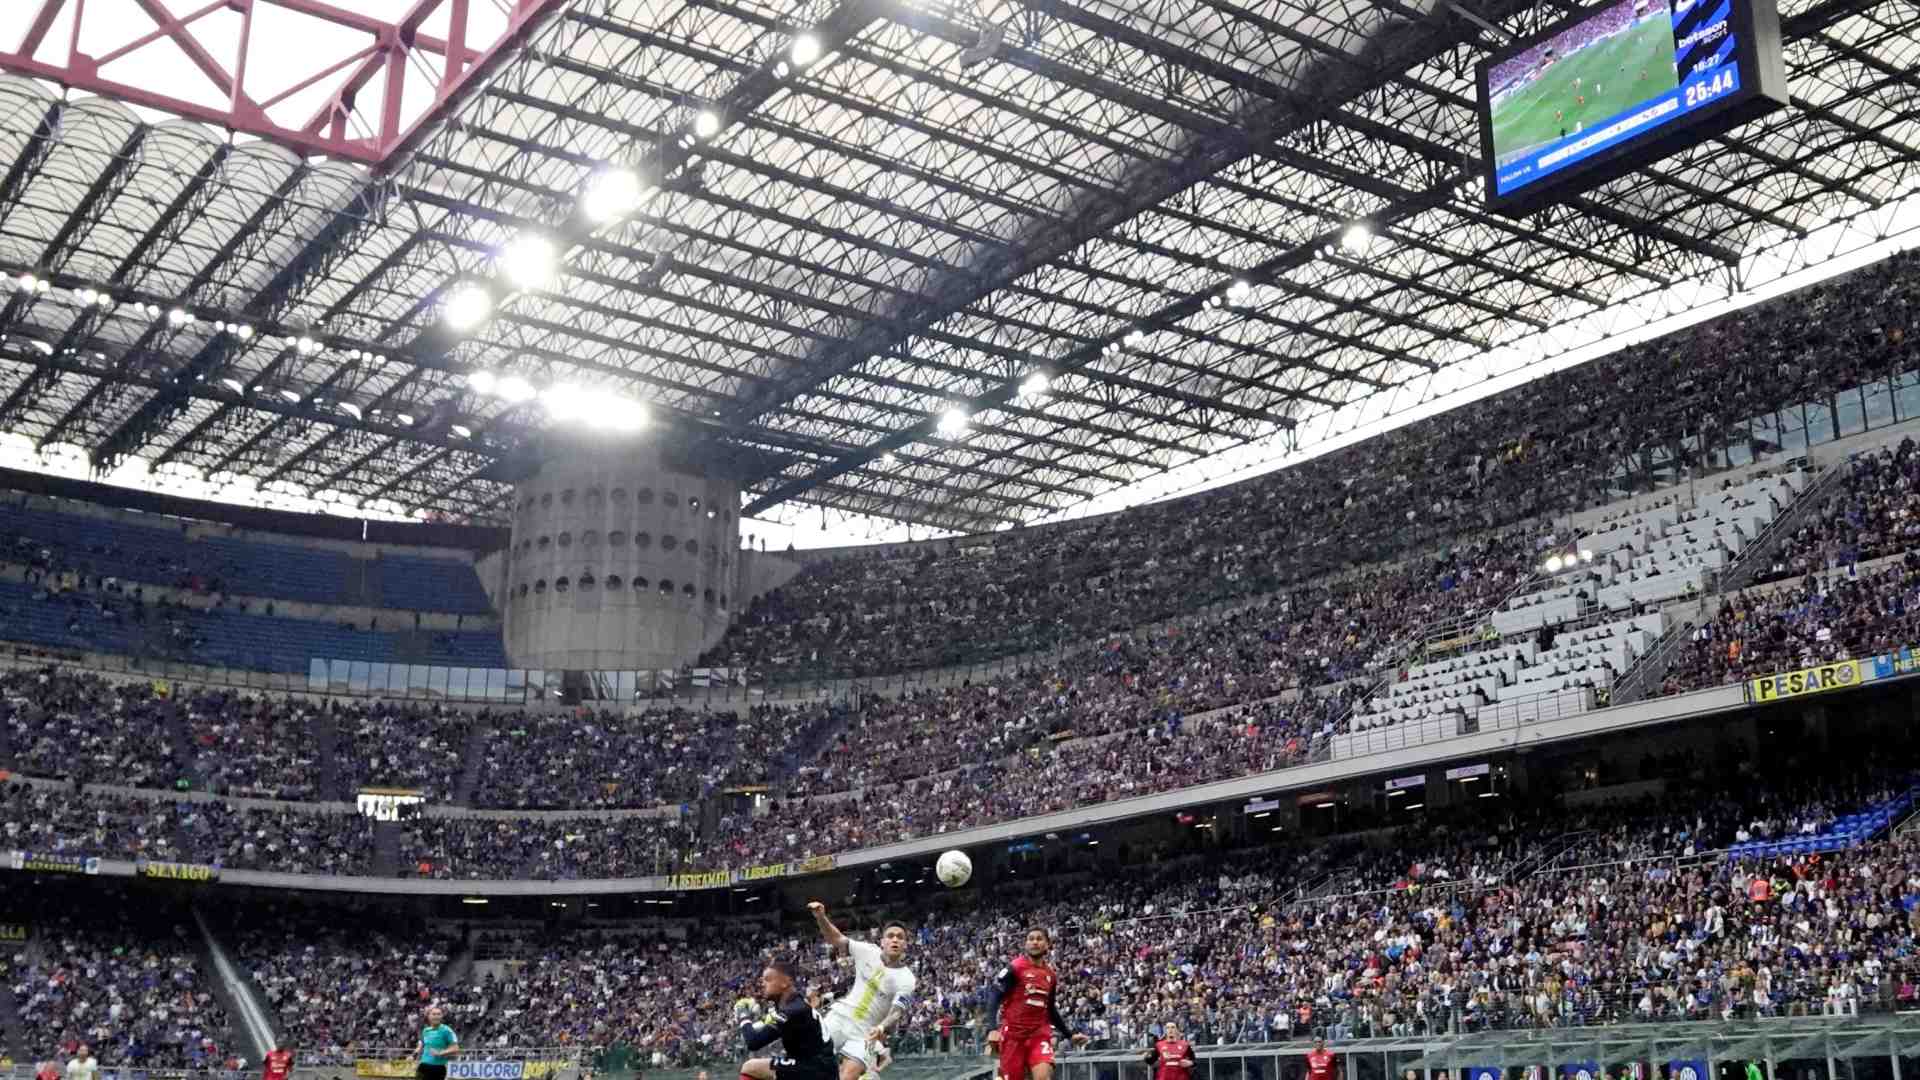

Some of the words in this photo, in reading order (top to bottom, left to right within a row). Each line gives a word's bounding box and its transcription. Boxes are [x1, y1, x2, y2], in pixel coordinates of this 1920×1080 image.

[1686, 69, 1733, 106] 25:44
[1759, 665, 1854, 699] PESARO
[450, 1063, 520, 1077] POLICORO
